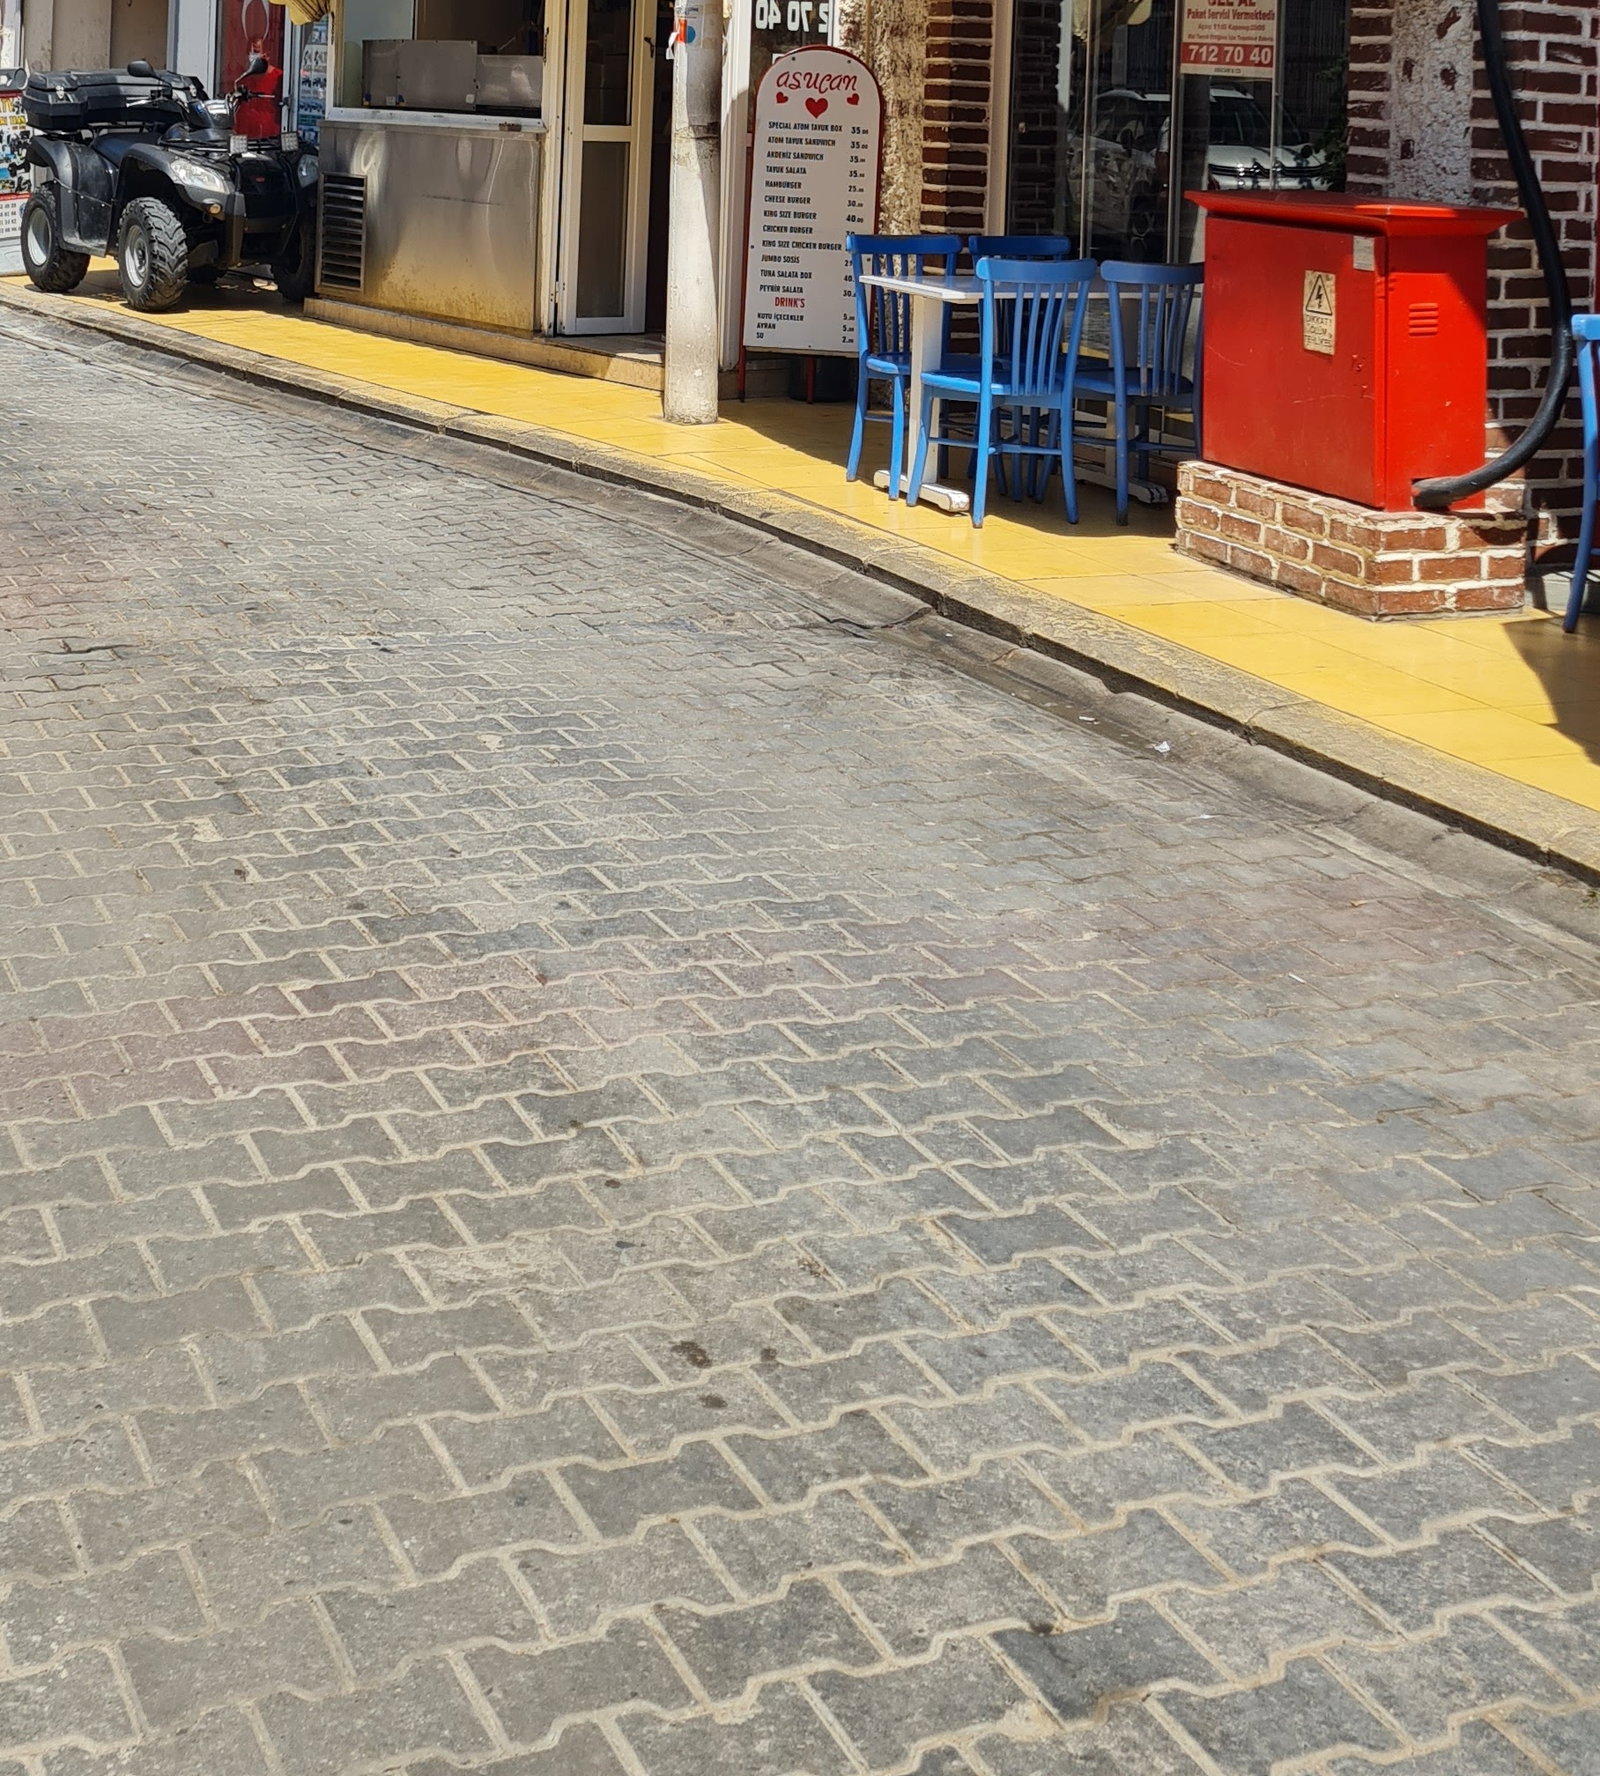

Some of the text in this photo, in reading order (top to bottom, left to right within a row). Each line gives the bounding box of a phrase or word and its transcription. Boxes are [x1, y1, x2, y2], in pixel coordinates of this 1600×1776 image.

[1188, 44, 1272, 64] 712 70 40
[768, 122, 791, 130] SPECIAL
[793, 122, 810, 131] ATOM
[811, 123, 829, 132] TAVUK
[830, 124, 843, 132] BOX
[767, 136, 784, 144] ATOM
[785, 137, 804, 145] TAVUK
[804, 138, 836, 147] SANDWICH
[792, 152, 824, 161] SANDWICH
[766, 165, 784, 174] TAVUK
[785, 166, 807, 175] SALATA
[765, 180, 802, 189] HAMBURGER
[764, 195, 786, 204] CHEESE
[787, 196, 811, 204] BURGER
[793, 211, 817, 219] BURGER
[762, 225, 813, 234] CHICKEN BURGER
[777, 240, 790, 248] SIZE
[791, 241, 817, 250] CHICKEN
[818, 243, 842, 251] BURGER
[761, 254, 782, 263] JUMBO
[760, 269, 776, 277] TUNA
[777, 270, 799, 278] SALATA
[800, 271, 813, 279] BOX
[782, 285, 803, 294] SALATA
